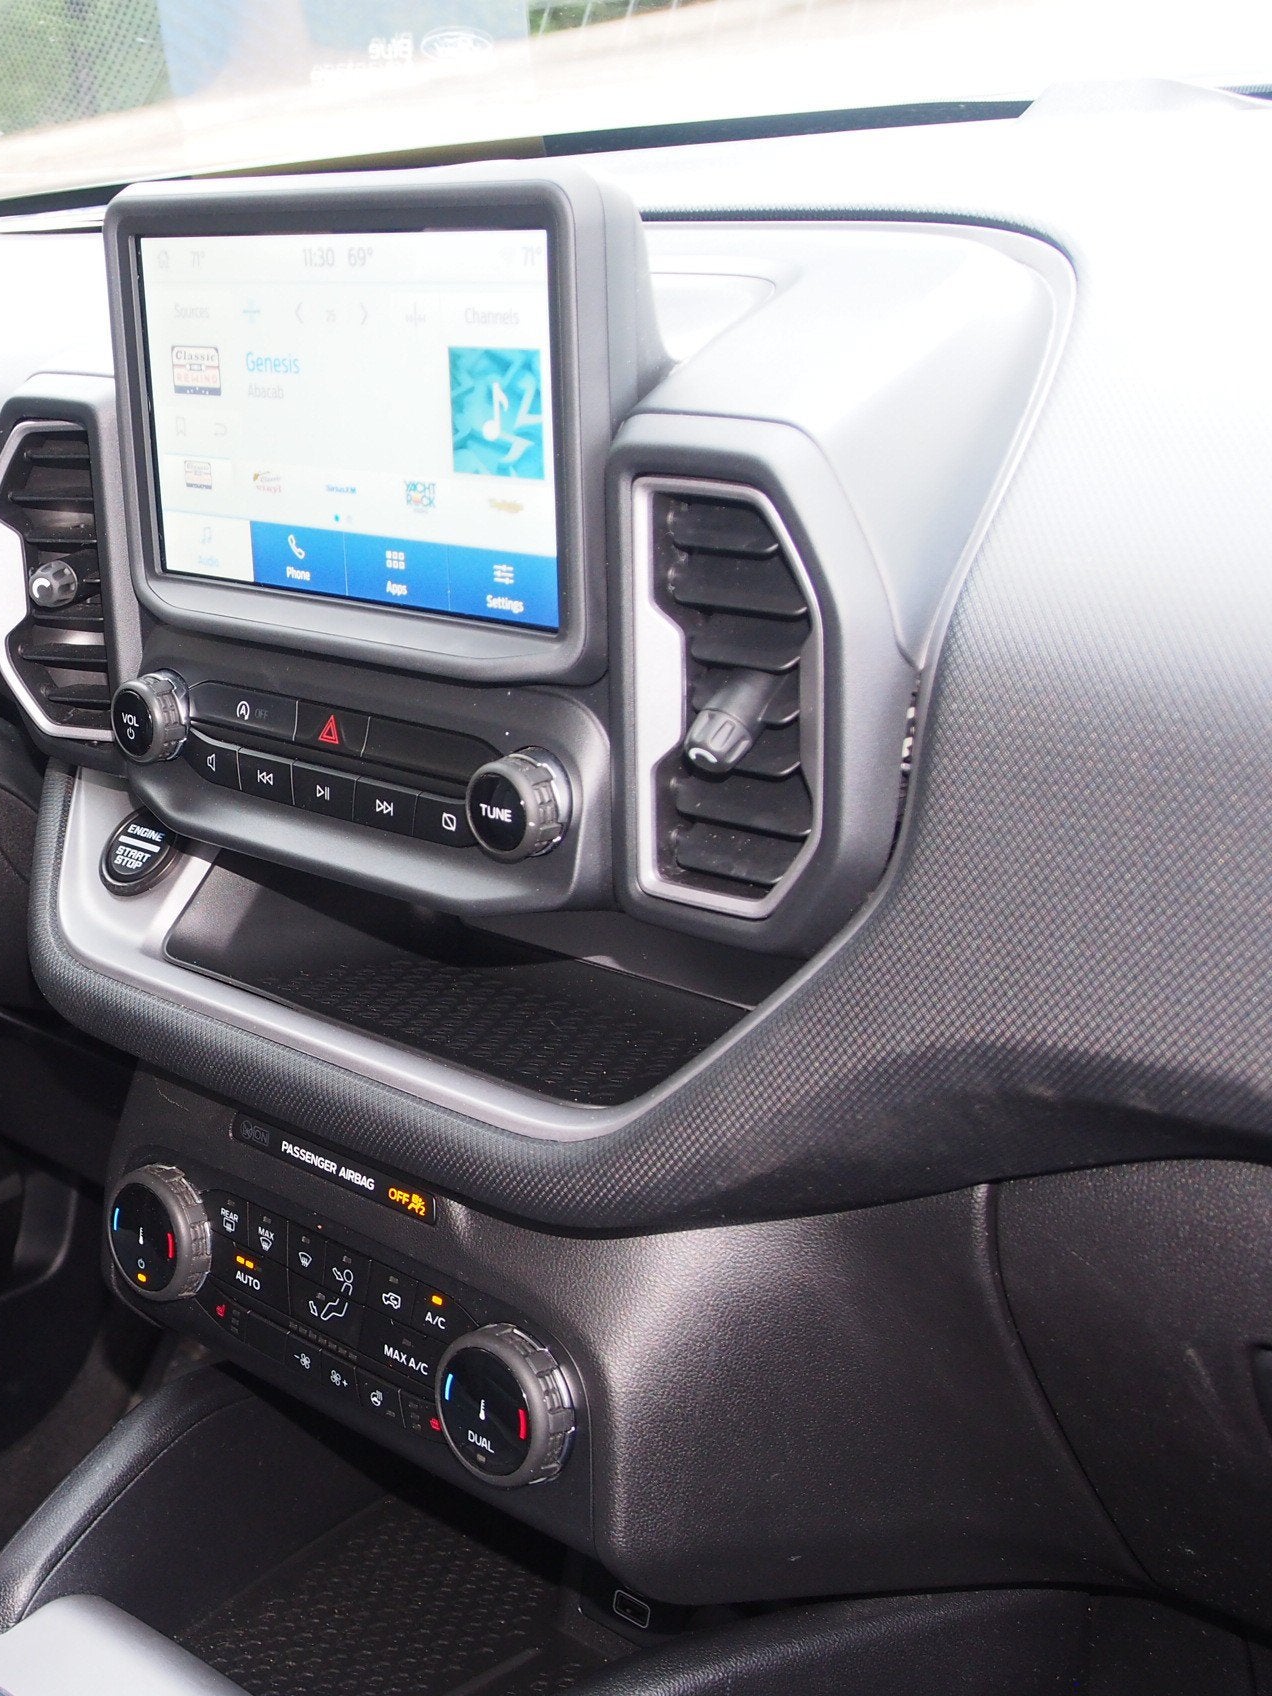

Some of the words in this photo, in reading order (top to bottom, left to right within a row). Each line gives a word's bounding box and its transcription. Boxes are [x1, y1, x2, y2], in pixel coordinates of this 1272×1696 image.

[303, 247, 334, 267] 11:30
[464, 307, 520, 325] Channels
[175, 350, 215, 361] Classic
[246, 352, 300, 374] Genesis
[248, 383, 284, 399] Abacab
[286, 567, 310, 581] Phone
[386, 581, 407, 597] Apps
[485, 595, 524, 614] Settings
[122, 712, 139, 727] VOL
[479, 803, 512, 822] TUNE
[128, 824, 165, 842] ENGINE
[114, 855, 143, 869] STOP
[116, 845, 151, 863] START
[281, 1140, 338, 1175] PASSENGER
[339, 1166, 375, 1191] AIRBAG
[388, 1187, 410, 1205] OFF
[221, 1207, 239, 1223] REAR
[258, 1226, 275, 1240] MAX
[235, 1270, 261, 1290] AUTO
[425, 1311, 446, 1330] A/C
[383, 1344, 407, 1365] MAX
[408, 1357, 429, 1376] A/C
[467, 1429, 495, 1454] DUAL
